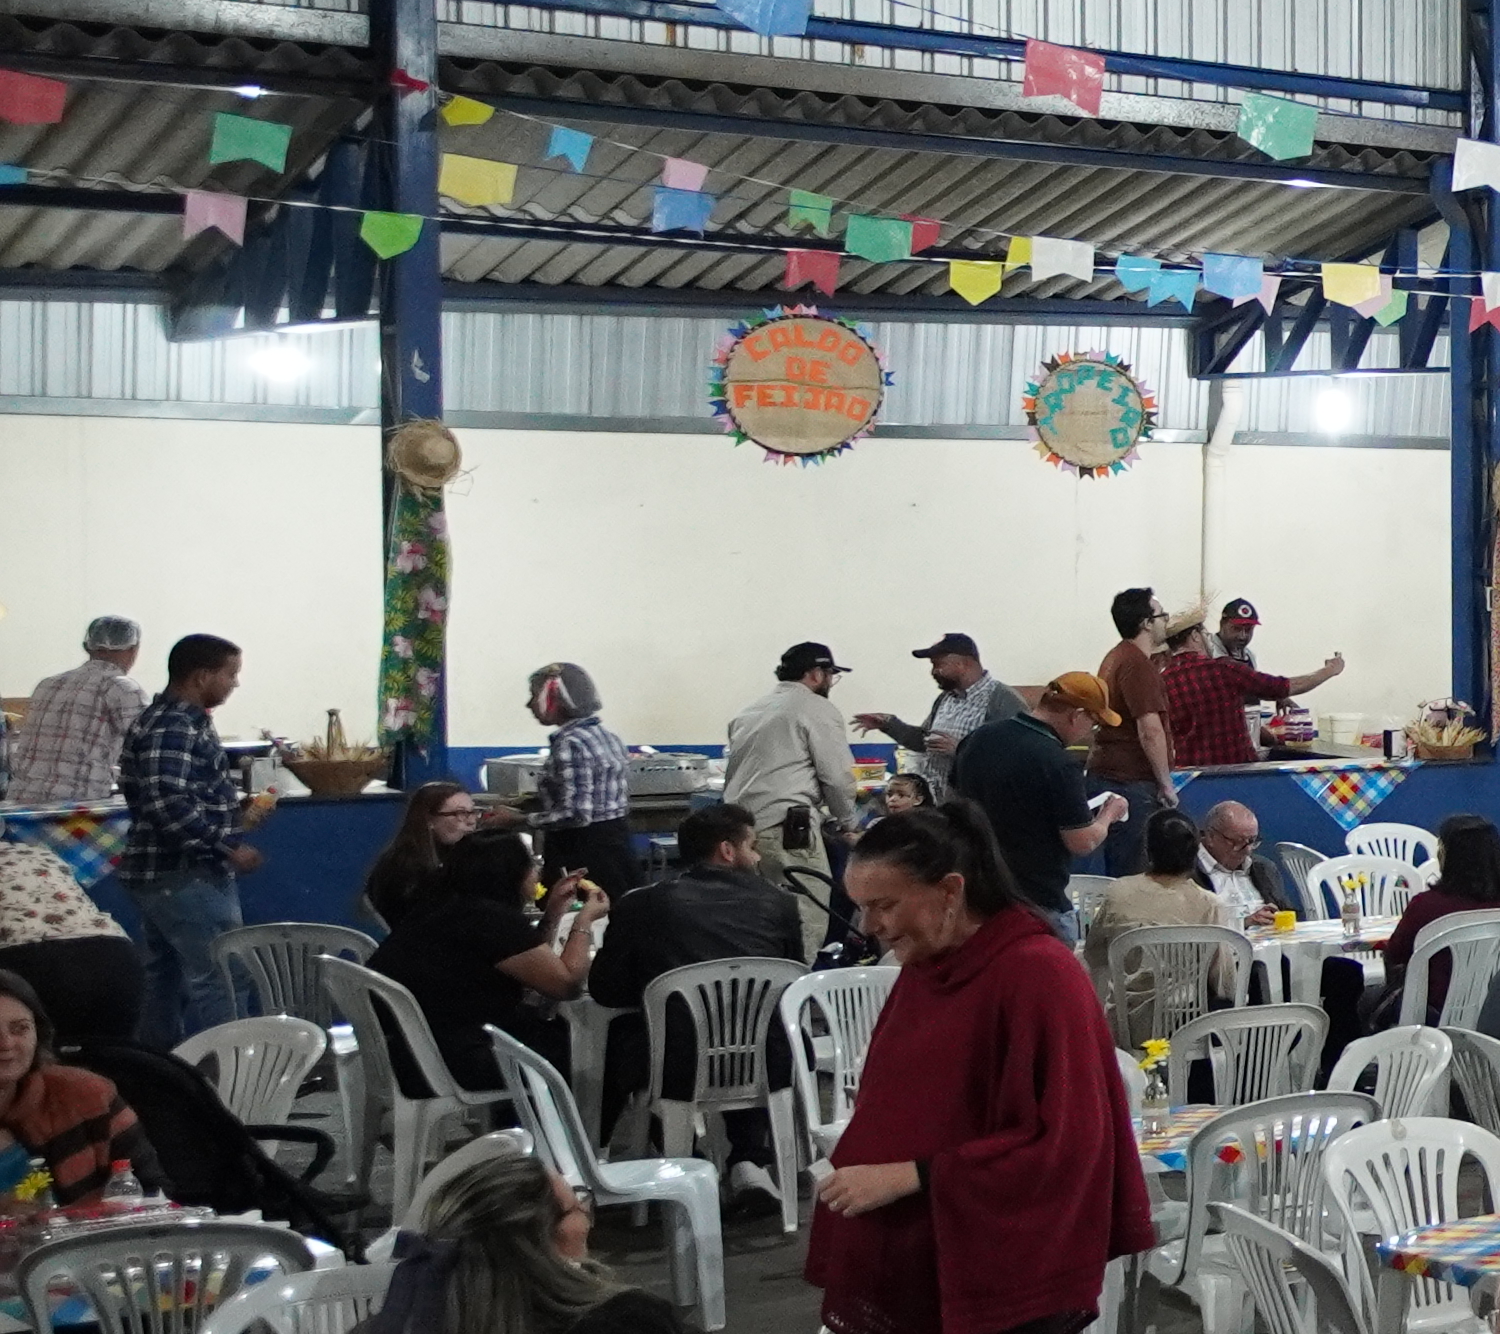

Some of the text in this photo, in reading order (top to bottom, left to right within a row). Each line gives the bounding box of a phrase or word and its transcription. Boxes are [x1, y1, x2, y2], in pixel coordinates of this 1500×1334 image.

[742, 324, 867, 367] CALDO
[784, 356, 832, 385] DE
[1038, 364, 1142, 449] TROPEIRO
